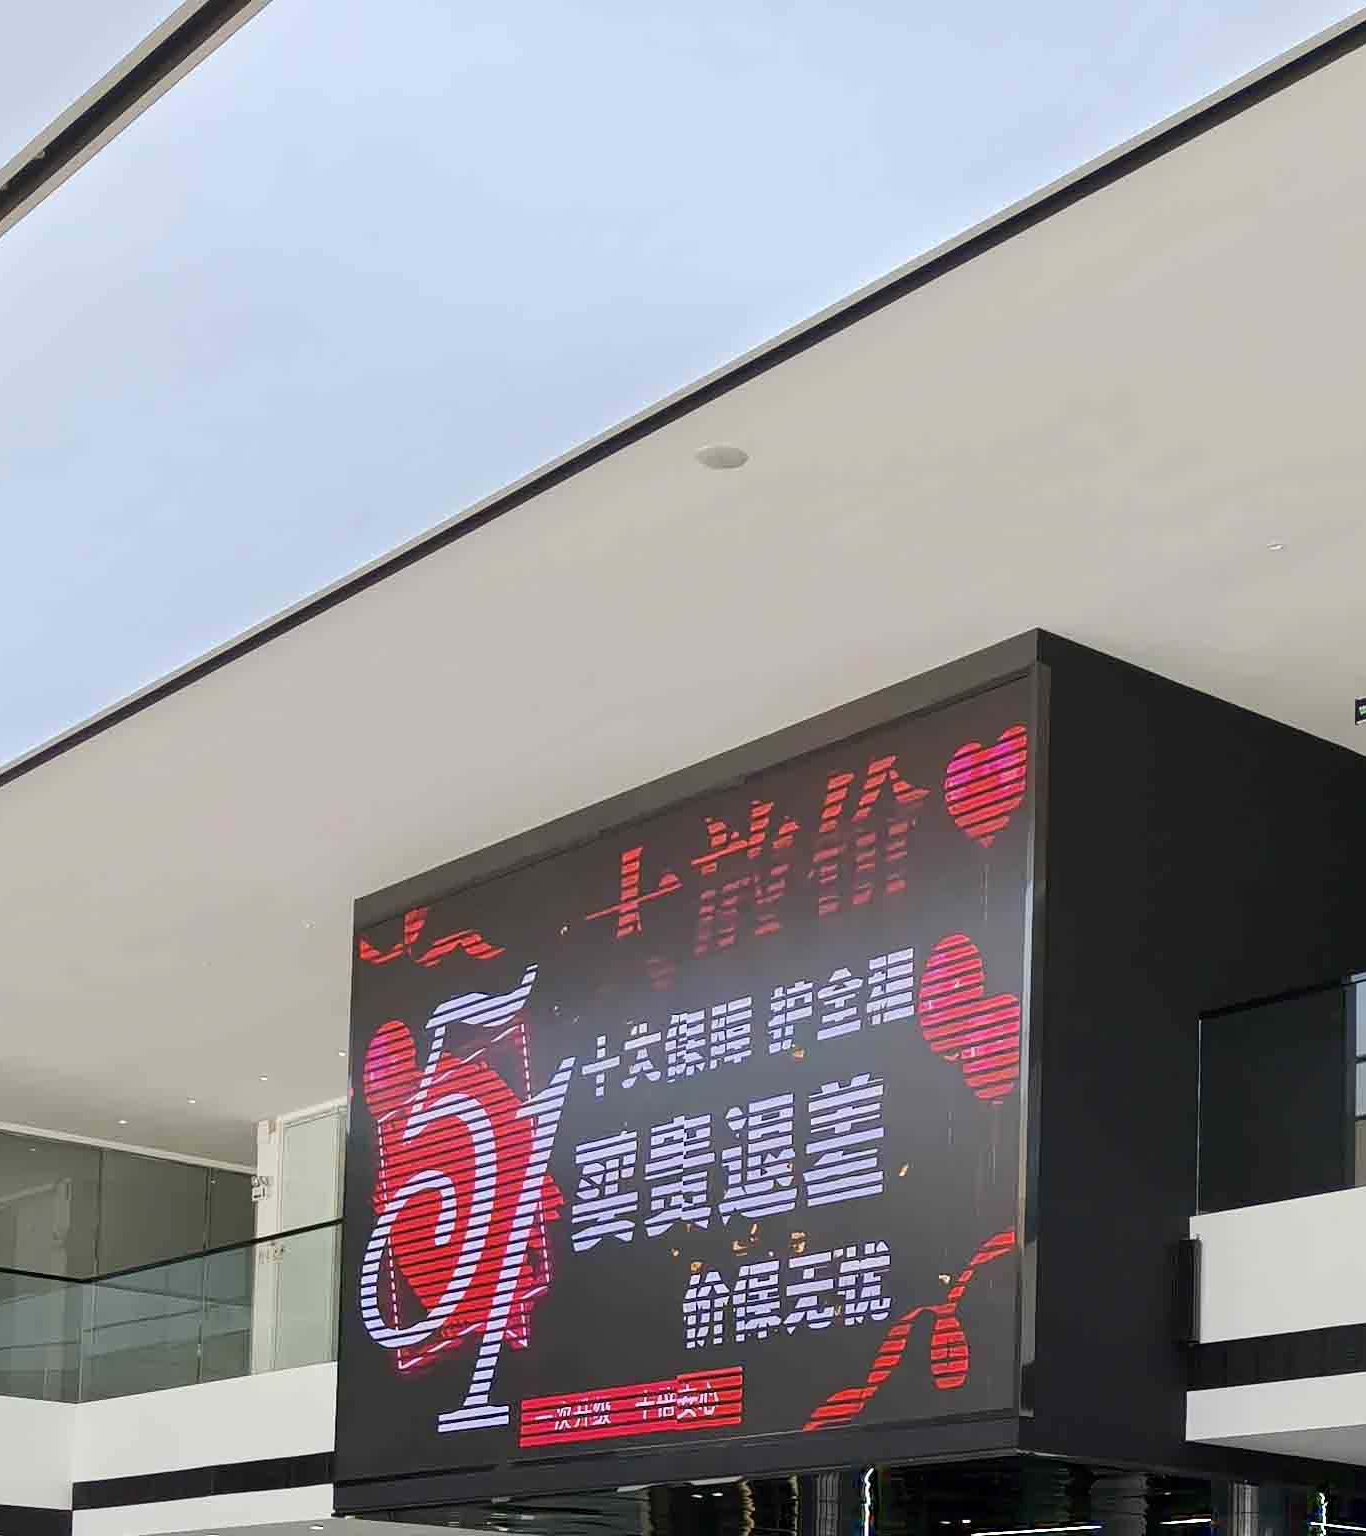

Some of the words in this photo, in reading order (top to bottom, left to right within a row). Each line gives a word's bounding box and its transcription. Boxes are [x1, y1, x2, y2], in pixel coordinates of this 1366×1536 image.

[581, 996, 752, 1097] 十大保障
[571, 1073, 885, 1252] 买贵退差
[681, 1240, 892, 1349] 价保无忧
